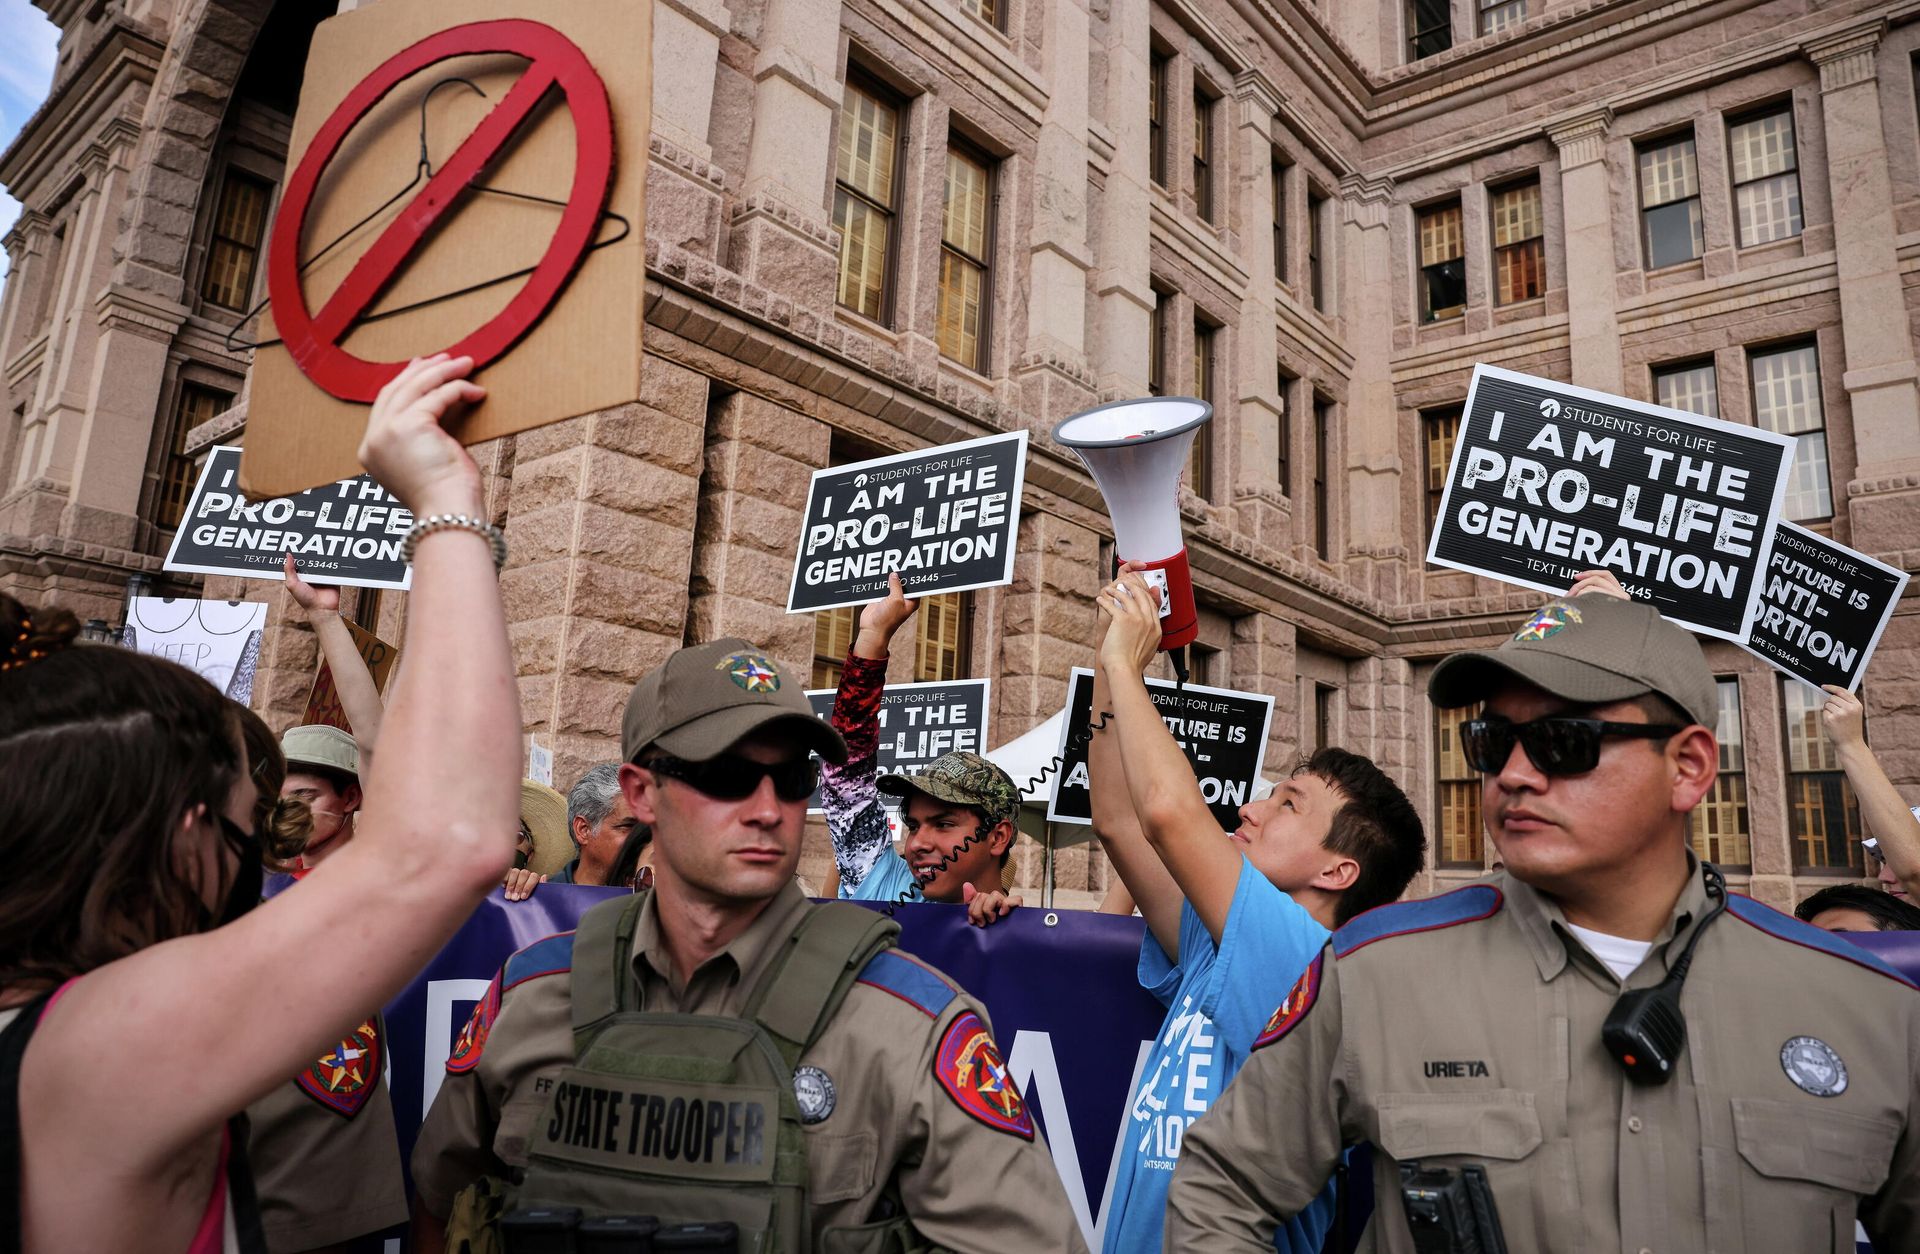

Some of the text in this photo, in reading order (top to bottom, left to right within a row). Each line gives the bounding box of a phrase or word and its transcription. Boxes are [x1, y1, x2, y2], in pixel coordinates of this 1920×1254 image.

[1563, 405, 1717, 454] STUDENTS FOR LIFE
[869, 455, 973, 484] STUDENTS FOR LIFE
[1488, 411, 1750, 501] I AM THE
[220, 469, 235, 488] I
[822, 465, 998, 518] I AM THE
[196, 491, 415, 536] PRO-LIFE
[1461, 446, 1759, 558] PRO-LIFE
[191, 524, 401, 562] GENERATION
[806, 491, 1008, 556] PRO-LIFE
[243, 554, 267, 564] TEXT
[307, 560, 338, 570] 53445
[804, 532, 998, 586] GENERATION
[1457, 501, 1740, 599] GENERATION
[1774, 530, 1859, 578] STUDENTS FOR LIFE
[851, 582, 873, 593] TEXT
[909, 572, 939, 585] 53445
[1526, 557, 1652, 600] TEXT LIF 3445
[1770, 551, 1871, 611] FUTURE IS
[1751, 634, 1800, 666] LIFE TO 53445
[881, 692, 946, 705] ENTS FOR LIFE
[904, 703, 968, 727] THE
[1186, 698, 1208, 710] FOR
[1209, 702, 1230, 714] LIFE
[878, 728, 977, 759] -LIFE
[1162, 716, 1247, 744] TURE IS
[1424, 1060, 1490, 1079] URIETA
[546, 1080, 765, 1166] STATE TROOPER
